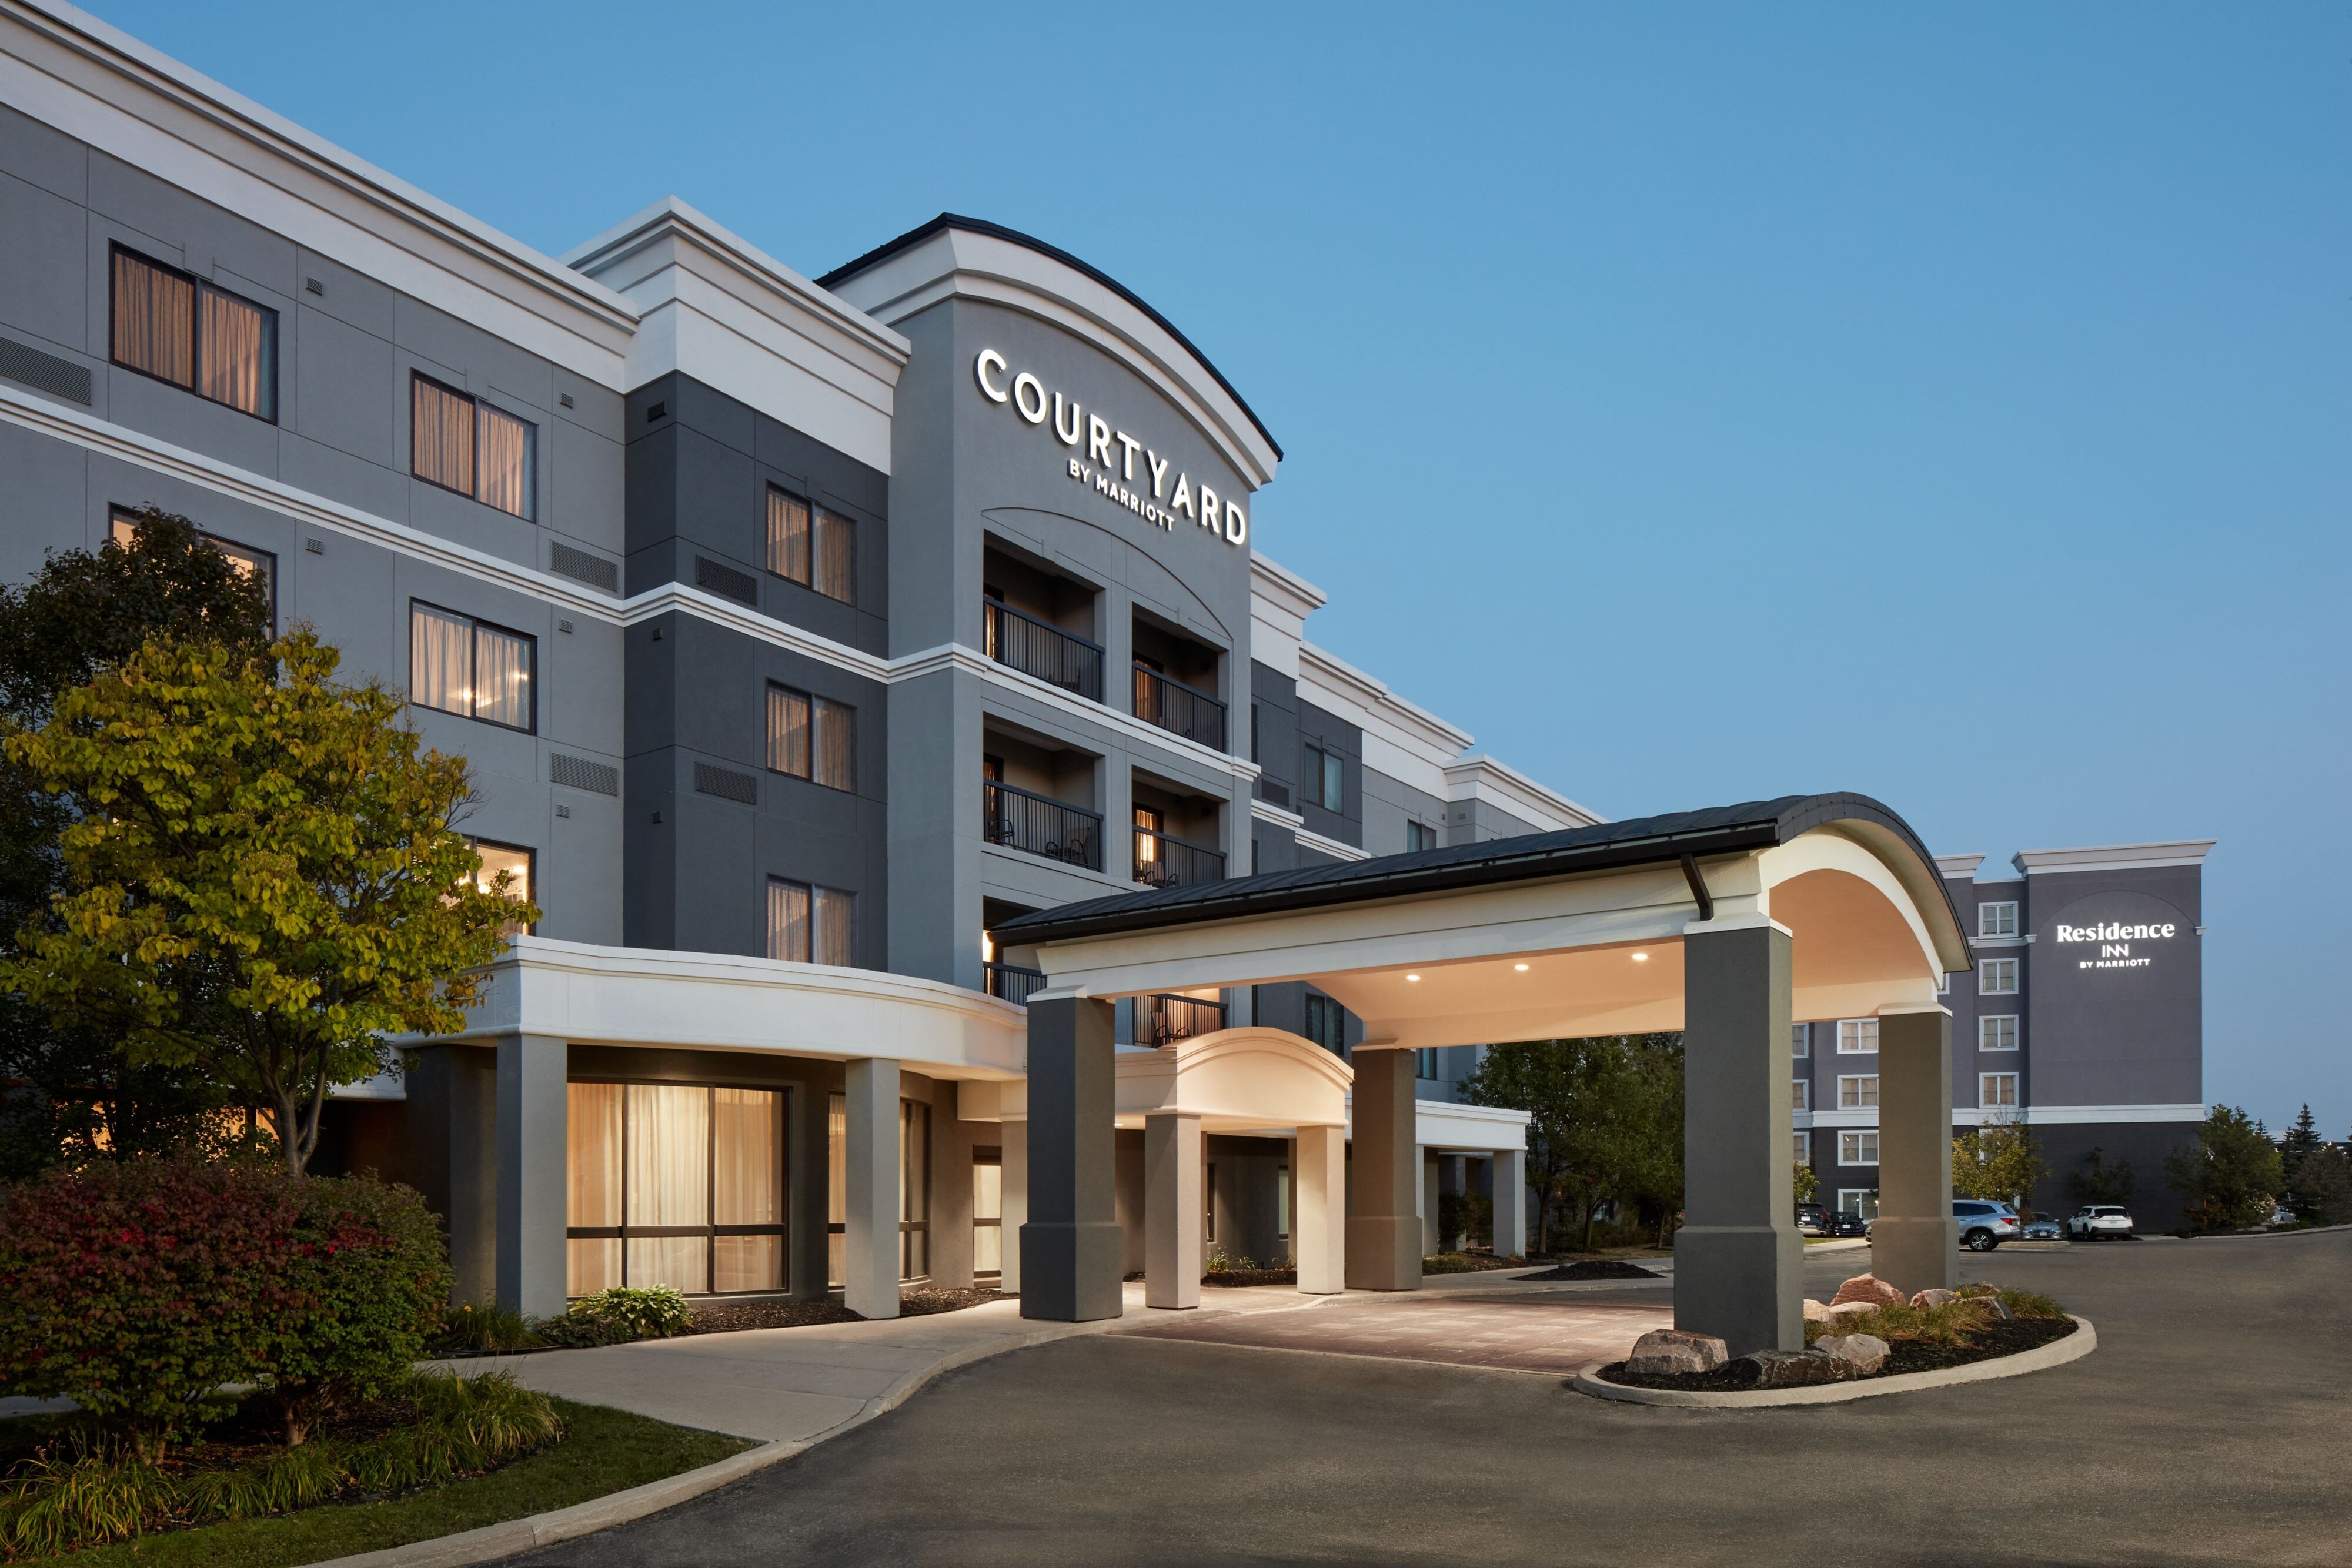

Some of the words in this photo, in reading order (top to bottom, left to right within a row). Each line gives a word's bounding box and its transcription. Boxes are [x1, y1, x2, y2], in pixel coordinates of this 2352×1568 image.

[974, 349, 1246, 544] COURTYARD
[1068, 459, 1090, 482] BY
[1095, 474, 1174, 531] MARRIOTT
[2057, 922, 2175, 942] Residence
[2102, 944, 2129, 958] INN
[2096, 959, 2150, 968] MARRIOTT
